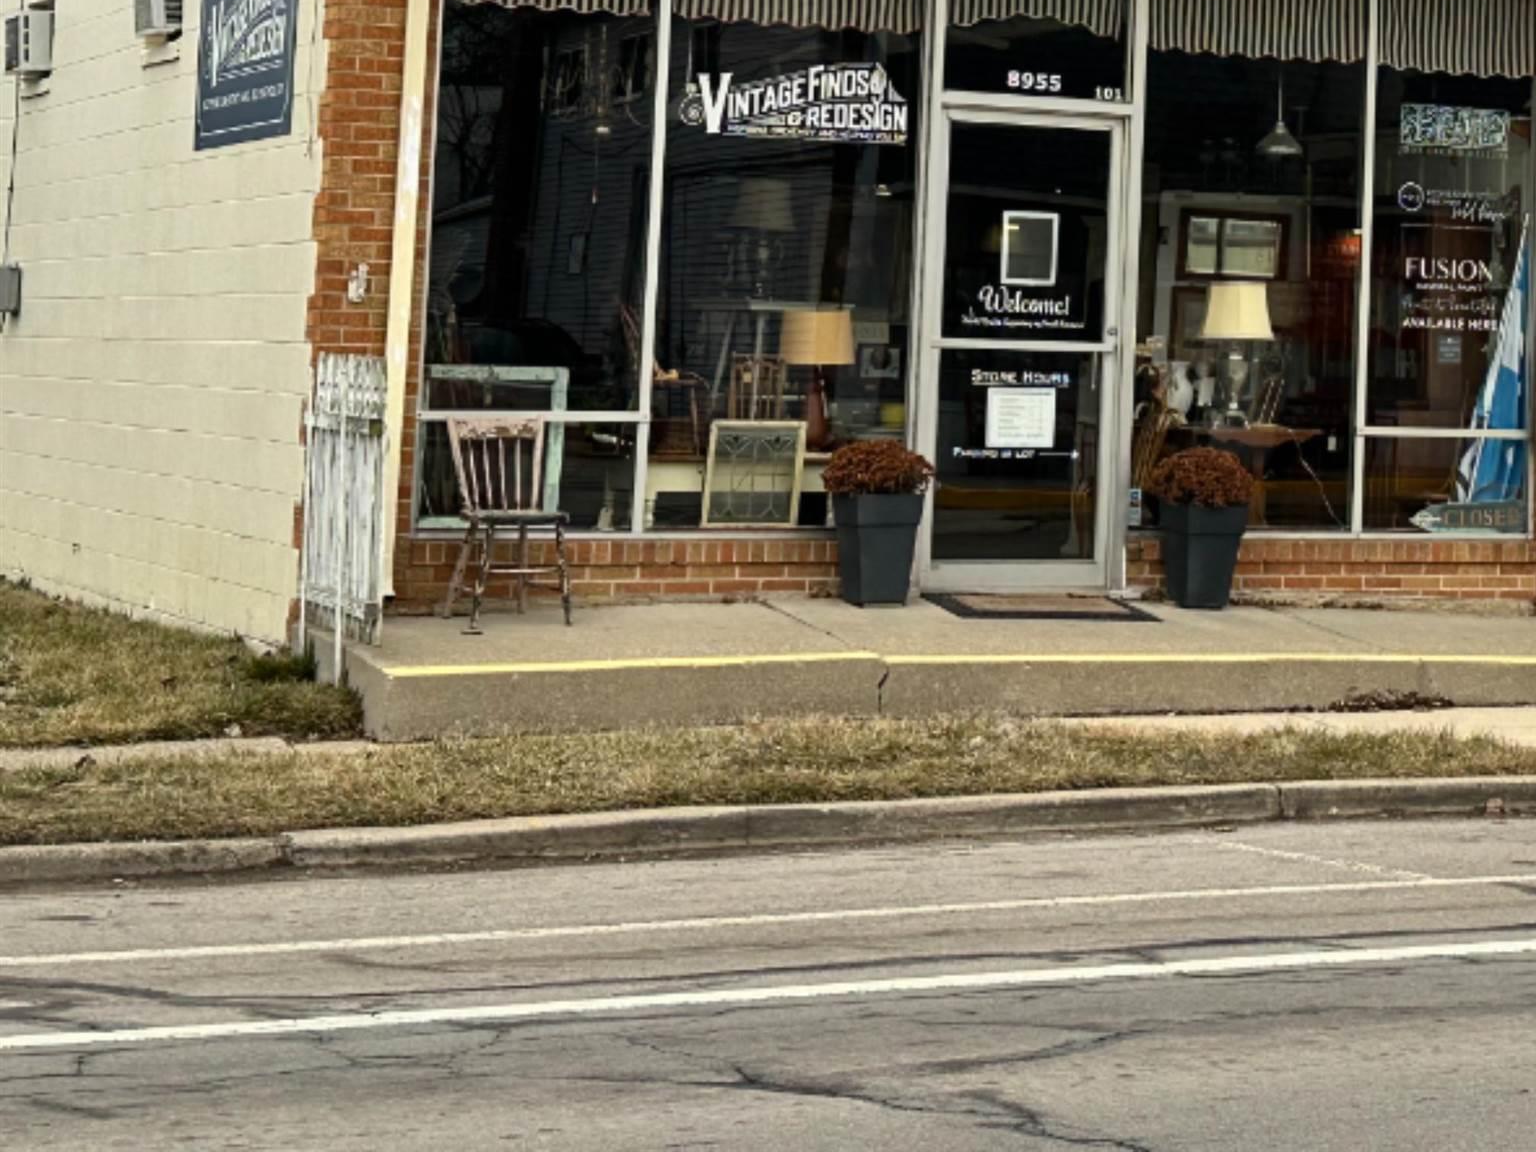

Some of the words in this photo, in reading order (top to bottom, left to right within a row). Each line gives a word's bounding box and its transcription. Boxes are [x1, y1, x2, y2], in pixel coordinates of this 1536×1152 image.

[1007, 69, 1062, 92] 8955
[1095, 85, 1121, 101] 101
[697, 71, 806, 134] VINTAGE
[808, 64, 869, 102] FINDS
[806, 102, 908, 132] REDESIGN
[1404, 257, 1493, 282] FUSION
[978, 284, 1070, 316] Welcome!
[1402, 317, 1465, 331] AVAILABLE
[1468, 318, 1499, 332] HERE
